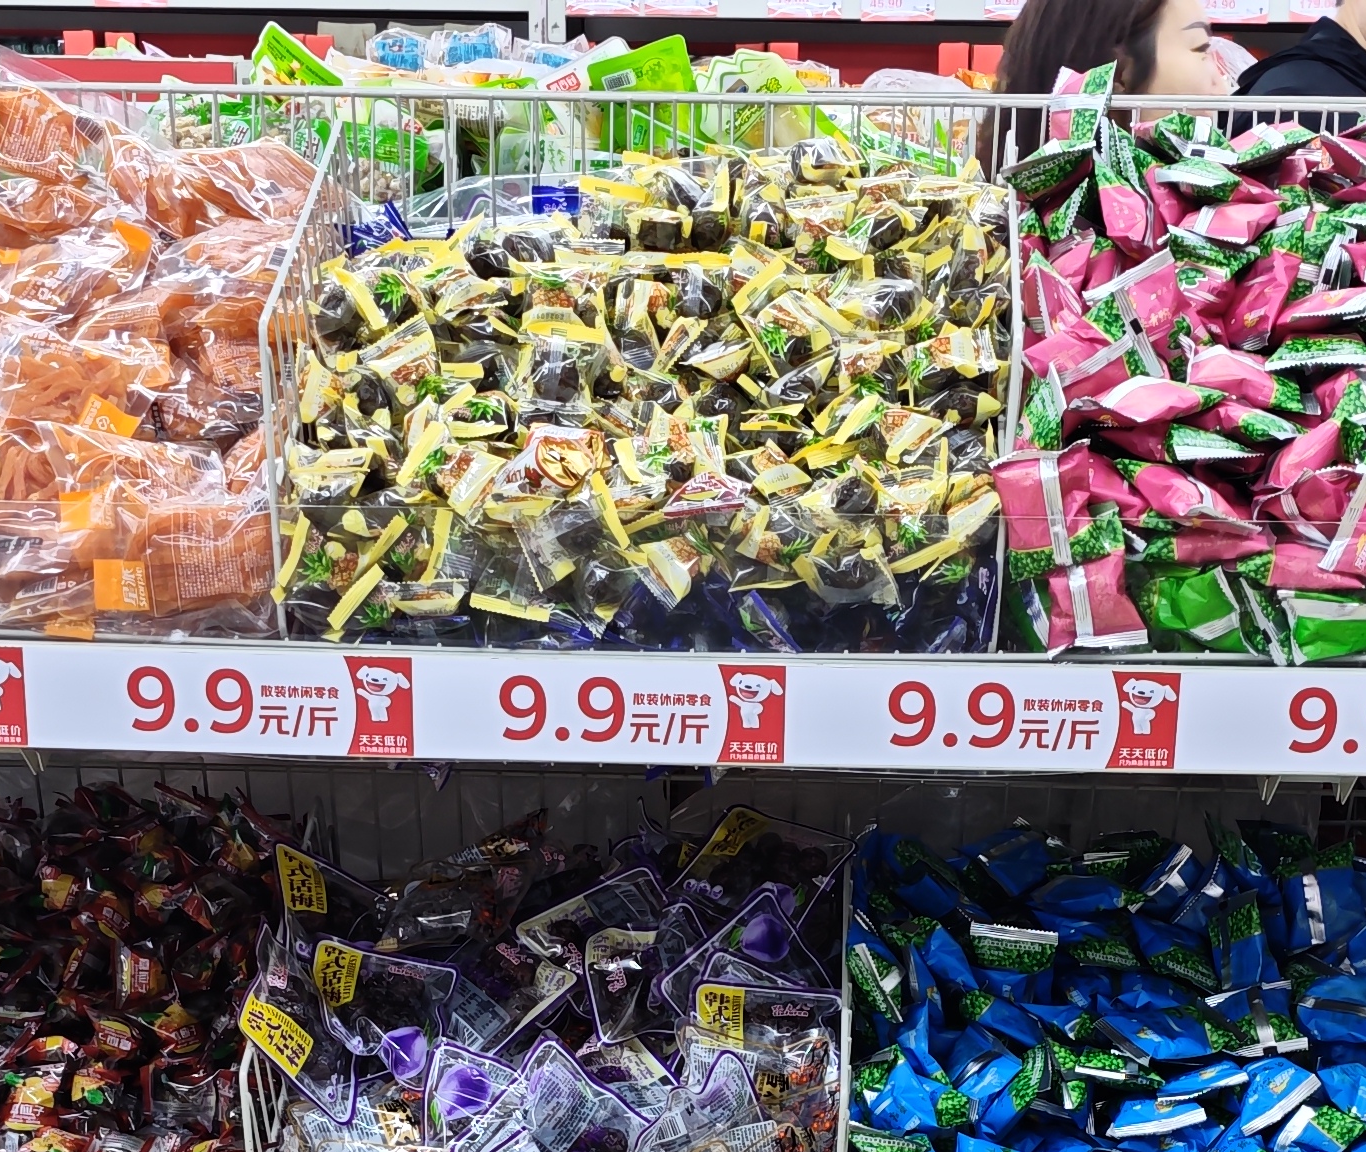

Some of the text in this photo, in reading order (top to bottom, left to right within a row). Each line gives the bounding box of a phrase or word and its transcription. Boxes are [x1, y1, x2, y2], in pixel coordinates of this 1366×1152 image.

[127, 666, 253, 734] 9.9
[260, 684, 340, 700] 散装休闲零食
[632, 692, 712, 707] 散装休闲零食
[499, 676, 625, 742] 9.9
[889, 681, 1015, 748] 9.9
[1023, 698, 1104, 713] 散装休闲零食
[259, 705, 338, 737] 元/斤
[630, 713, 709, 745] 元/斤
[358, 735, 408, 746] 天天低价
[1019, 719, 1099, 751] 元/斤
[729, 742, 778, 753] 天天低价
[1118, 748, 1169, 759] 天天低价
